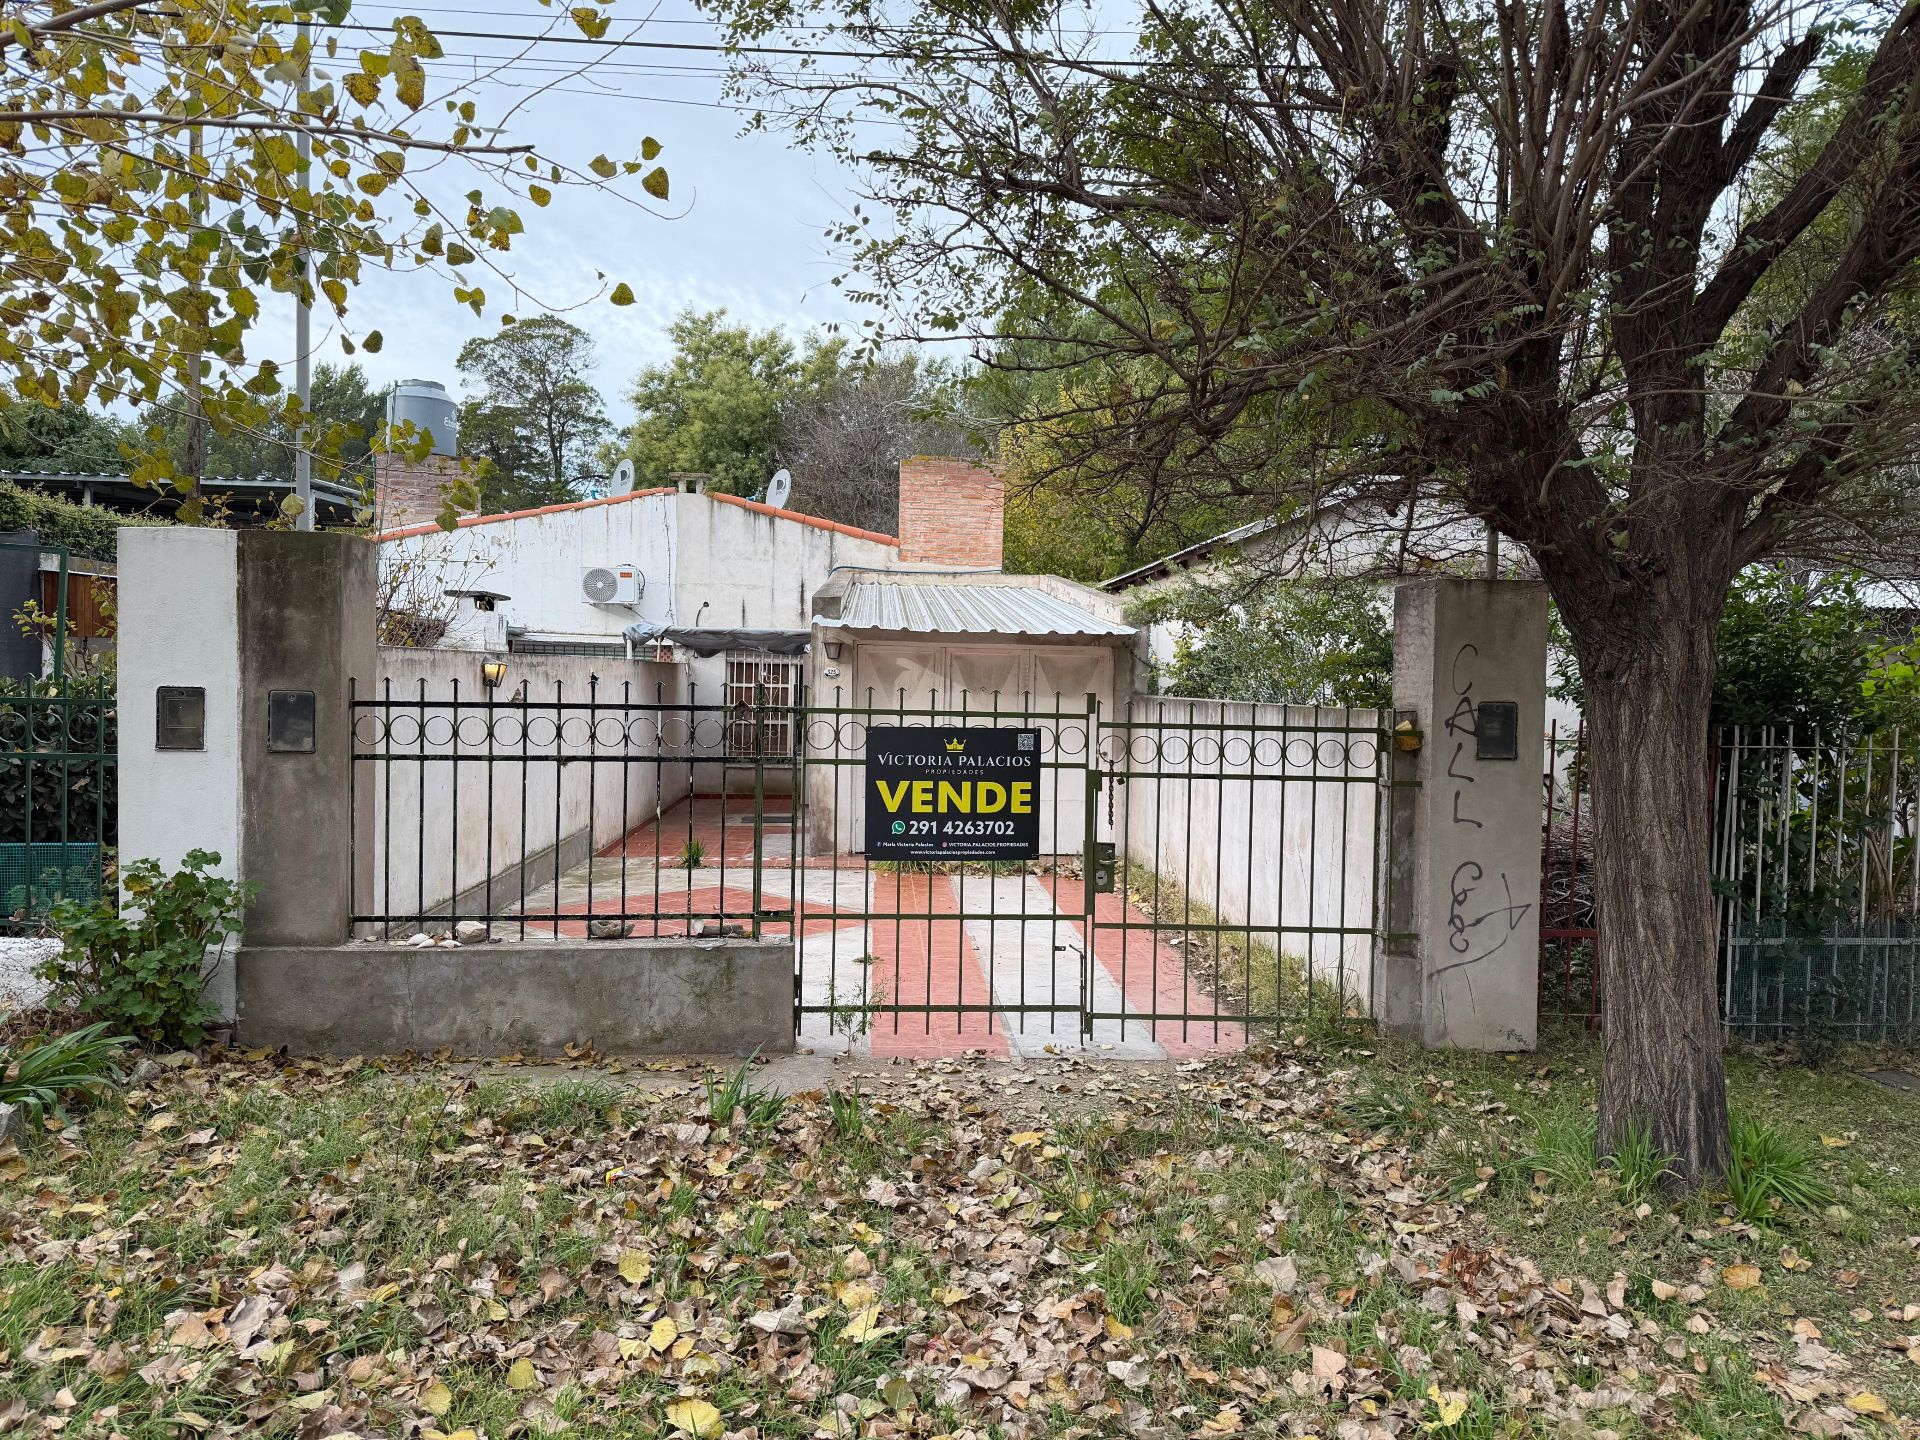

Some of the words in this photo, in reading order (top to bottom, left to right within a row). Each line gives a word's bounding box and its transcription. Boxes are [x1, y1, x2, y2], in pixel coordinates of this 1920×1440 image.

[878, 752, 952, 766] VICTORIA
[959, 755, 1031, 767] PALACIOS
[875, 780, 1032, 814] VENDE
[908, 821, 937, 835] 291
[943, 821, 1015, 835] 4263702
